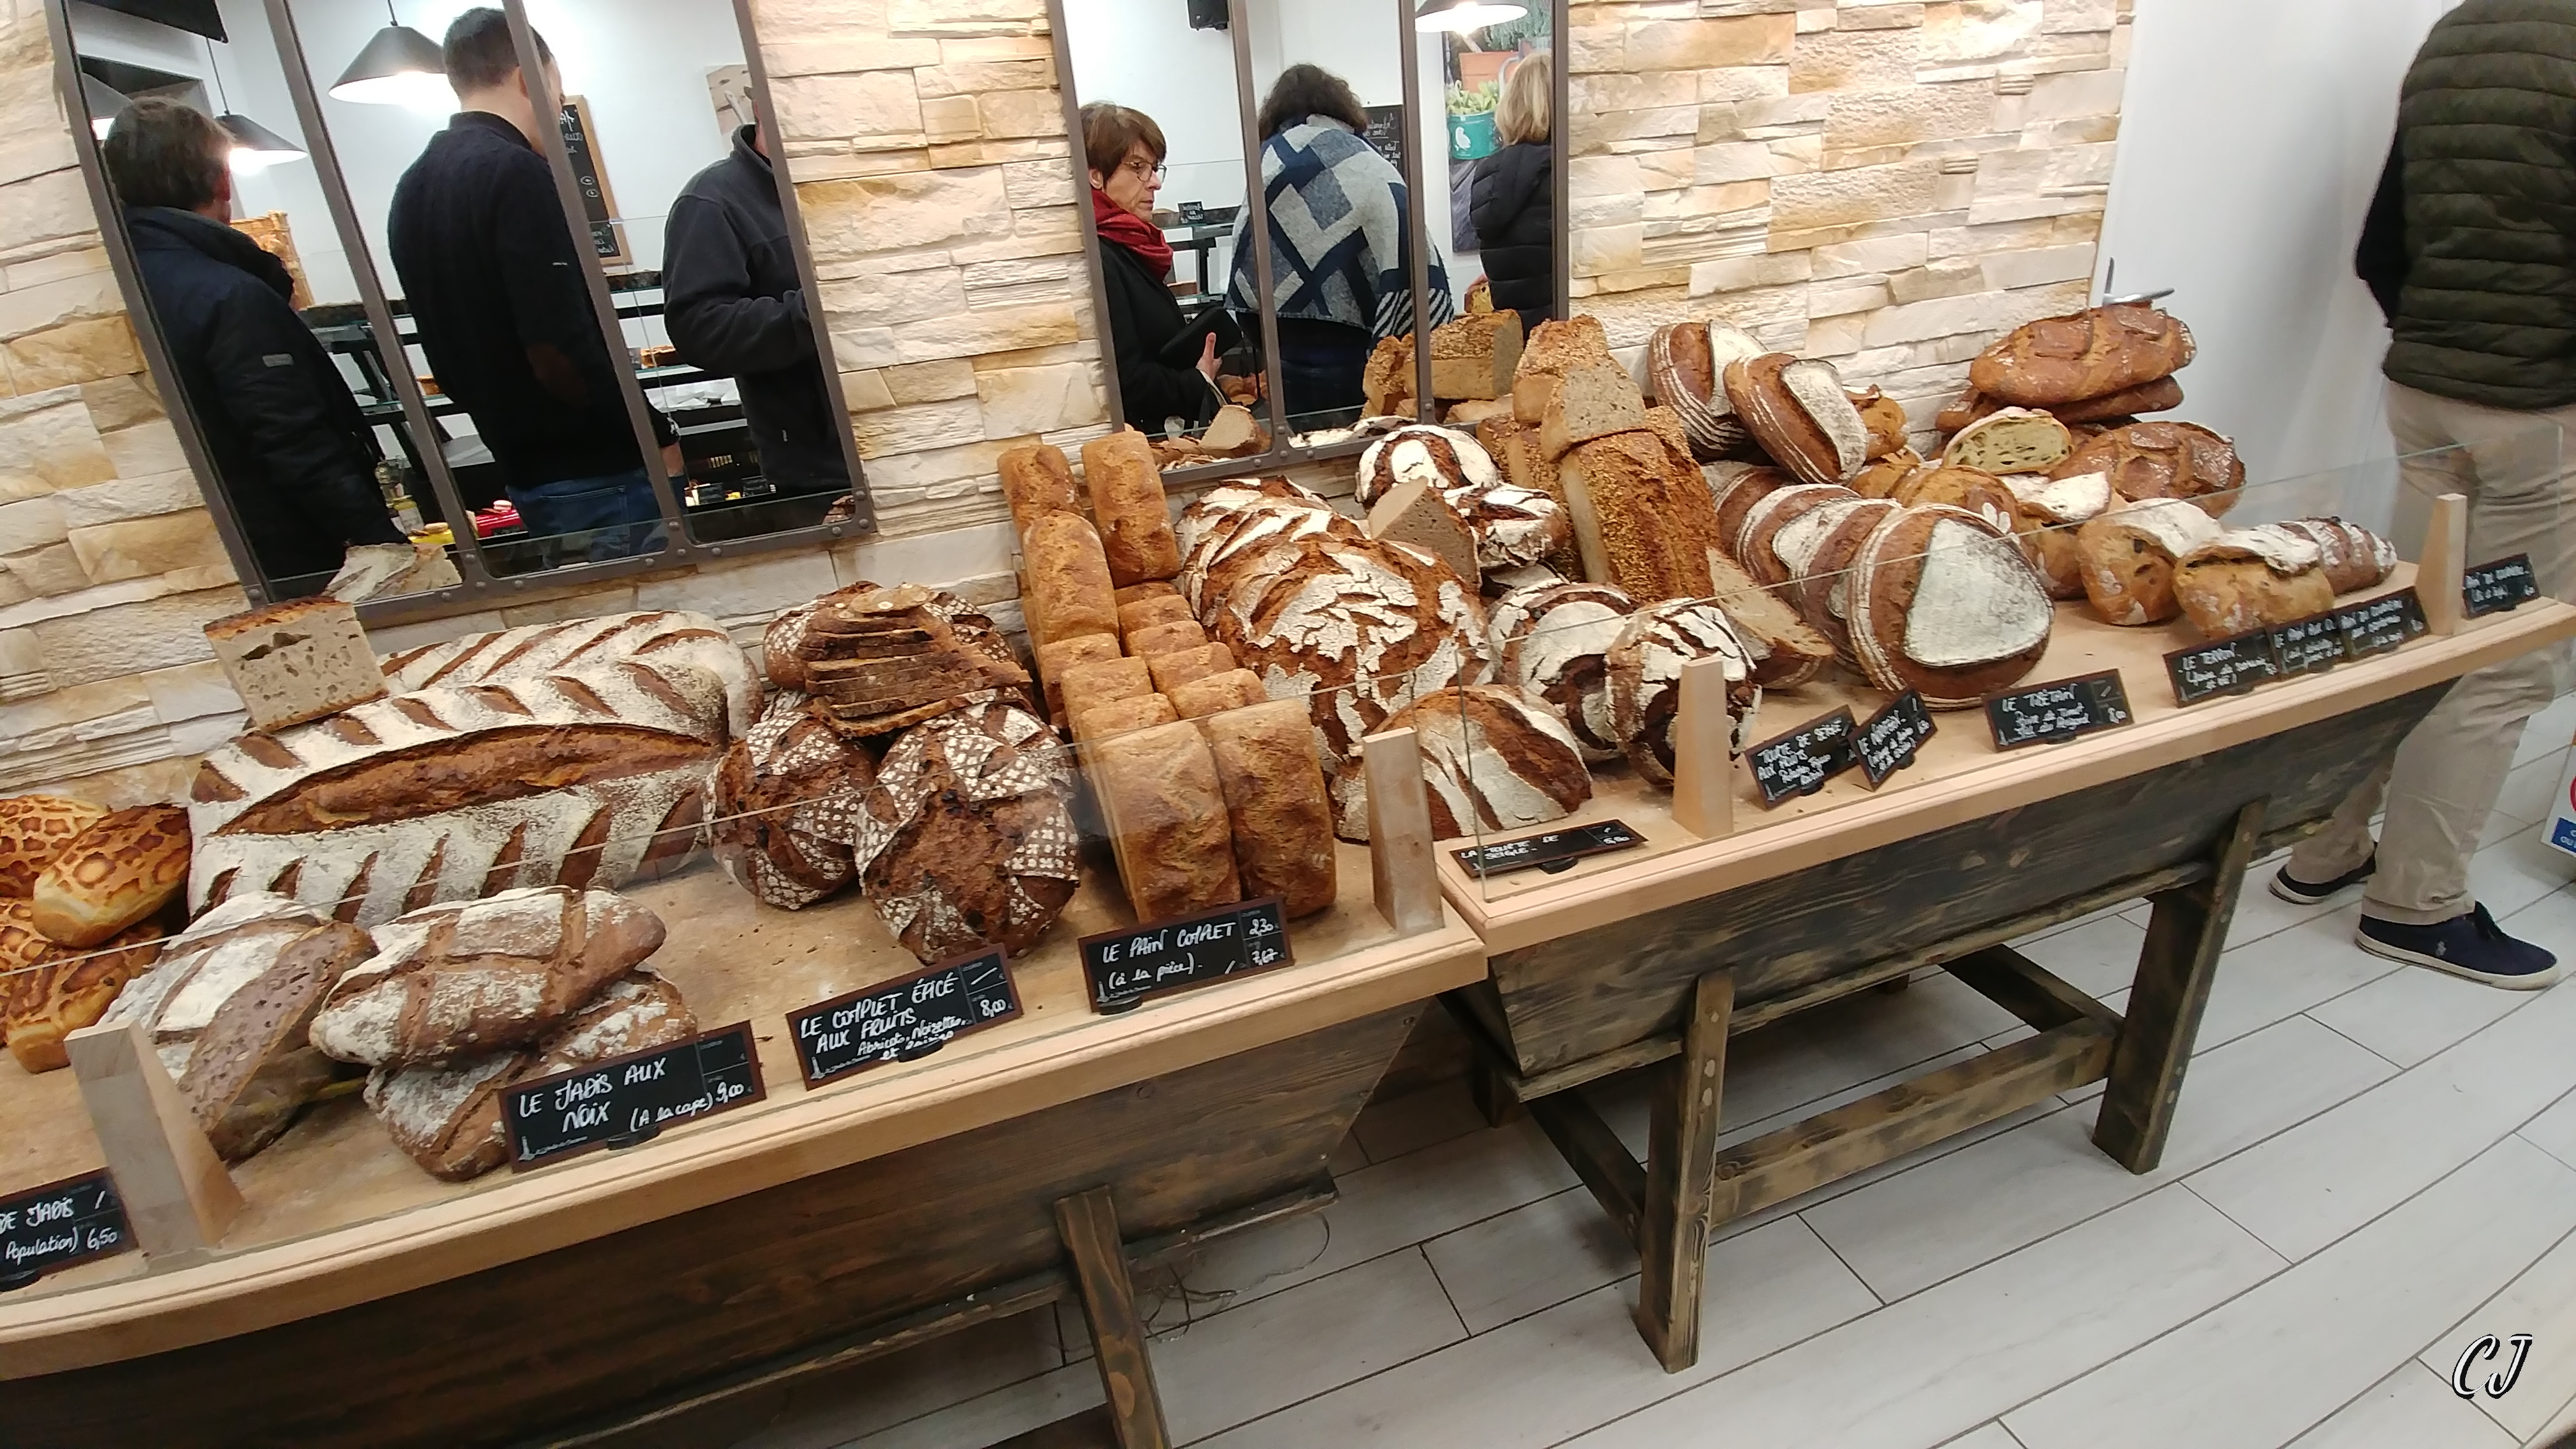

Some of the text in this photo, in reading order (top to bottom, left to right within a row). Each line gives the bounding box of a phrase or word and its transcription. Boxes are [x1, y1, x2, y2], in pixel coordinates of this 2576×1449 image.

[2002, 697, 2017, 712] LE
[1460, 835, 1559, 859] LA TOURTE DE
[1103, 944, 1121, 964] LE
[1177, 921, 1237, 947] COMPLET
[1131, 968, 1152, 981] la
[800, 1016, 823, 1038] LE
[832, 992, 904, 1029] COMPLET
[980, 998, 1007, 1018] 8,00
[816, 1029, 850, 1054] AUX
[519, 1094, 544, 1118] LE
[624, 1057, 666, 1086] AUX
[87, 1227, 118, 1251] 6,50
